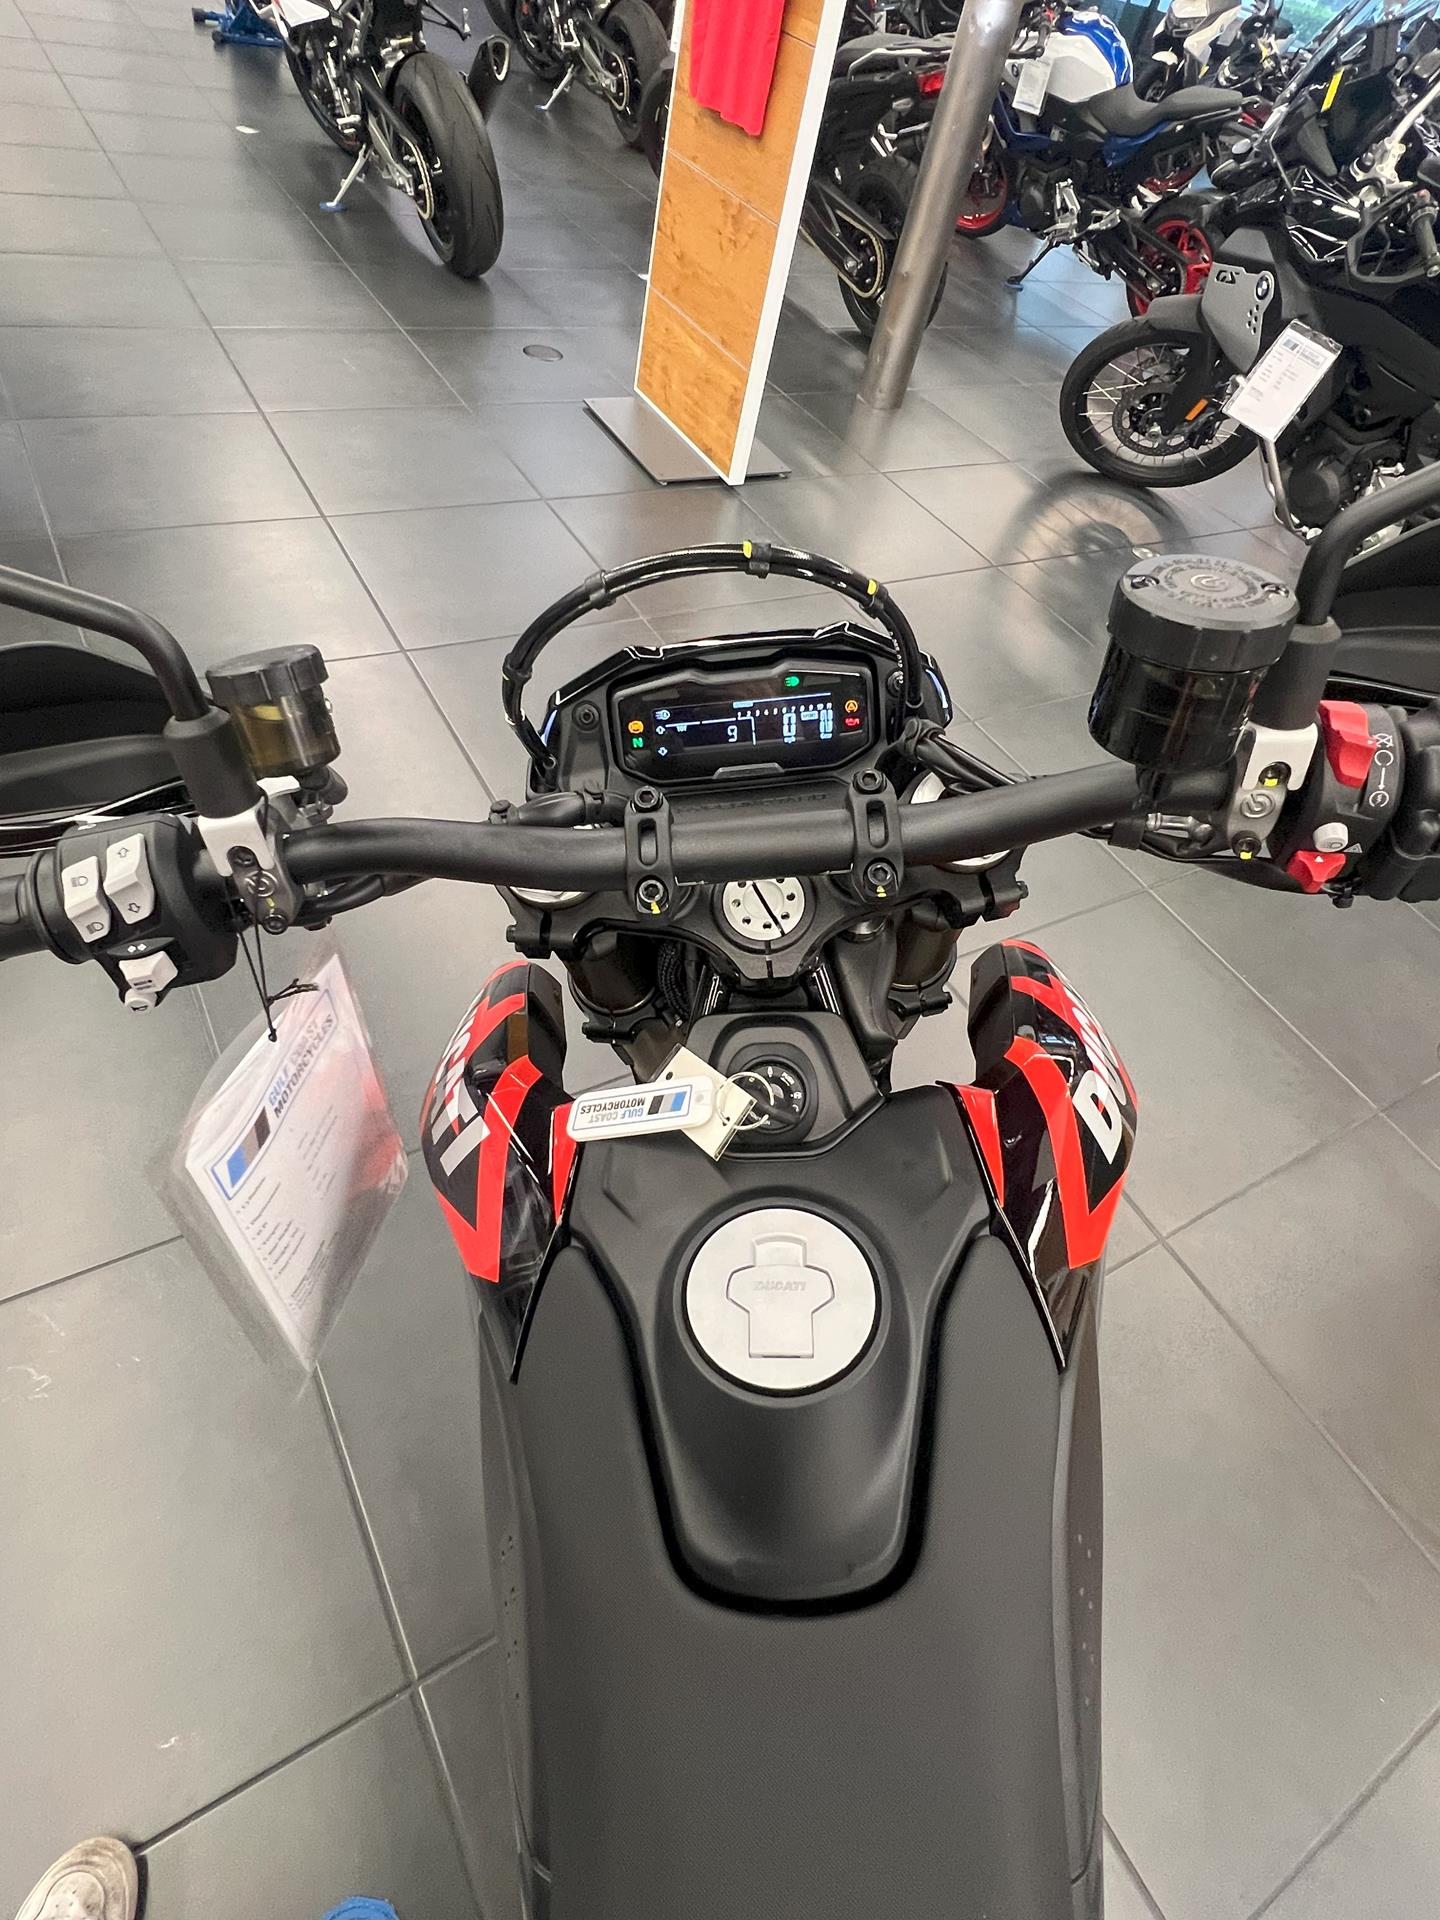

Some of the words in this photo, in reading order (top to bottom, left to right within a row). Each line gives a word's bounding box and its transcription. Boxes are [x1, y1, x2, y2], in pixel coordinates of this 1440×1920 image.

[1215, 269, 1240, 284] GS
[632, 737, 644, 748] N
[273, 1012, 334, 1119] MOTORCYCLES
[579, 1096, 645, 1115] MOTORCYCLES
[588, 1110, 618, 1124] COAST
[620, 1107, 643, 1120] GULF
[753, 1280, 807, 1291] DUCATI
